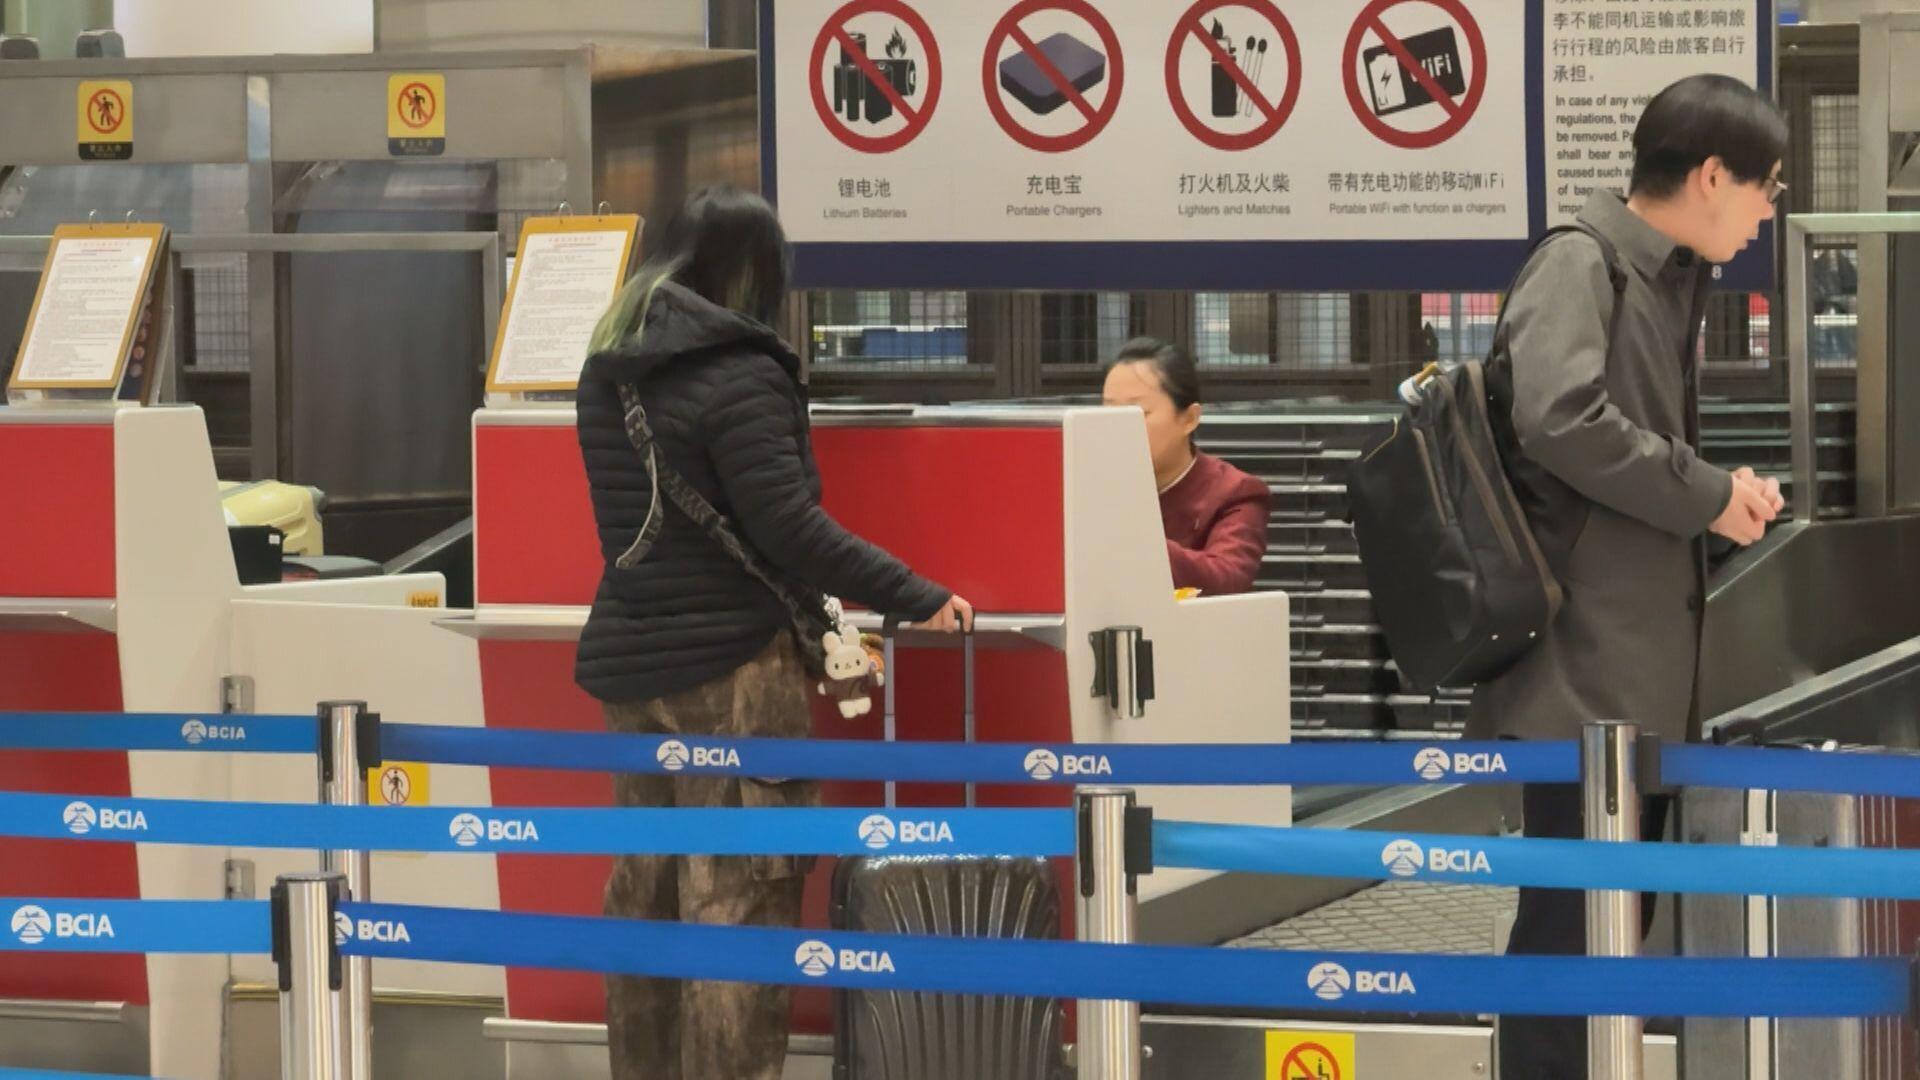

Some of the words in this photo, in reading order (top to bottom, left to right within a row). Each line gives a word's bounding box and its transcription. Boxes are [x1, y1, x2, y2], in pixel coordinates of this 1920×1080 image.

[1553, 10, 1745, 30] 李不能同机运输或影响旅
[1553, 36, 1744, 56] 行行程的风险由旅客自行
[1556, 96, 1566, 106] In
[1569, 97, 1592, 106] case
[1596, 95, 1607, 106] of
[1610, 97, 1629, 108] any
[1620, 113, 1636, 124] the
[1556, 132, 1569, 142] be
[1557, 149, 1581, 160] shall
[1588, 149, 1611, 160] bear
[1328, 171, 1504, 192] 带有充电功能的移动WiFi
[1557, 166, 1594, 178] caused
[1597, 166, 1622, 178] such
[838, 177, 892, 198] 锂电池
[1026, 175, 1082, 195] 充电宝
[1179, 172, 1290, 194] 打火机及火柴
[1558, 184, 1568, 195] of
[823, 208, 860, 218] Lithium
[862, 207, 908, 218] Batteries
[1006, 205, 1050, 216] Portable
[1053, 204, 1103, 218] Chargers
[1178, 204, 1220, 218] Lighters
[1223, 204, 1243, 214] and
[1246, 203, 1291, 215] Matches
[1329, 203, 1367, 214] Portable
[1369, 203, 1390, 214] WiFi
[1392, 203, 1411, 214] with
[1413, 203, 1449, 214] function
[1452, 205, 1463, 213] as
[1466, 203, 1507, 216] chargers
[208, 726, 246, 740] BCIA
[692, 746, 741, 767] BCIA
[1063, 754, 1112, 775] BCIA
[1454, 752, 1507, 774] BCIA
[99, 808, 148, 830] BCIA
[489, 820, 539, 842] BCIA
[899, 821, 954, 843] BCIA
[1429, 848, 1492, 873] BCIA
[56, 912, 115, 937] BCIA
[357, 919, 410, 943] BCIA
[839, 949, 896, 973] BCIA
[1355, 970, 1416, 994] BCIA
